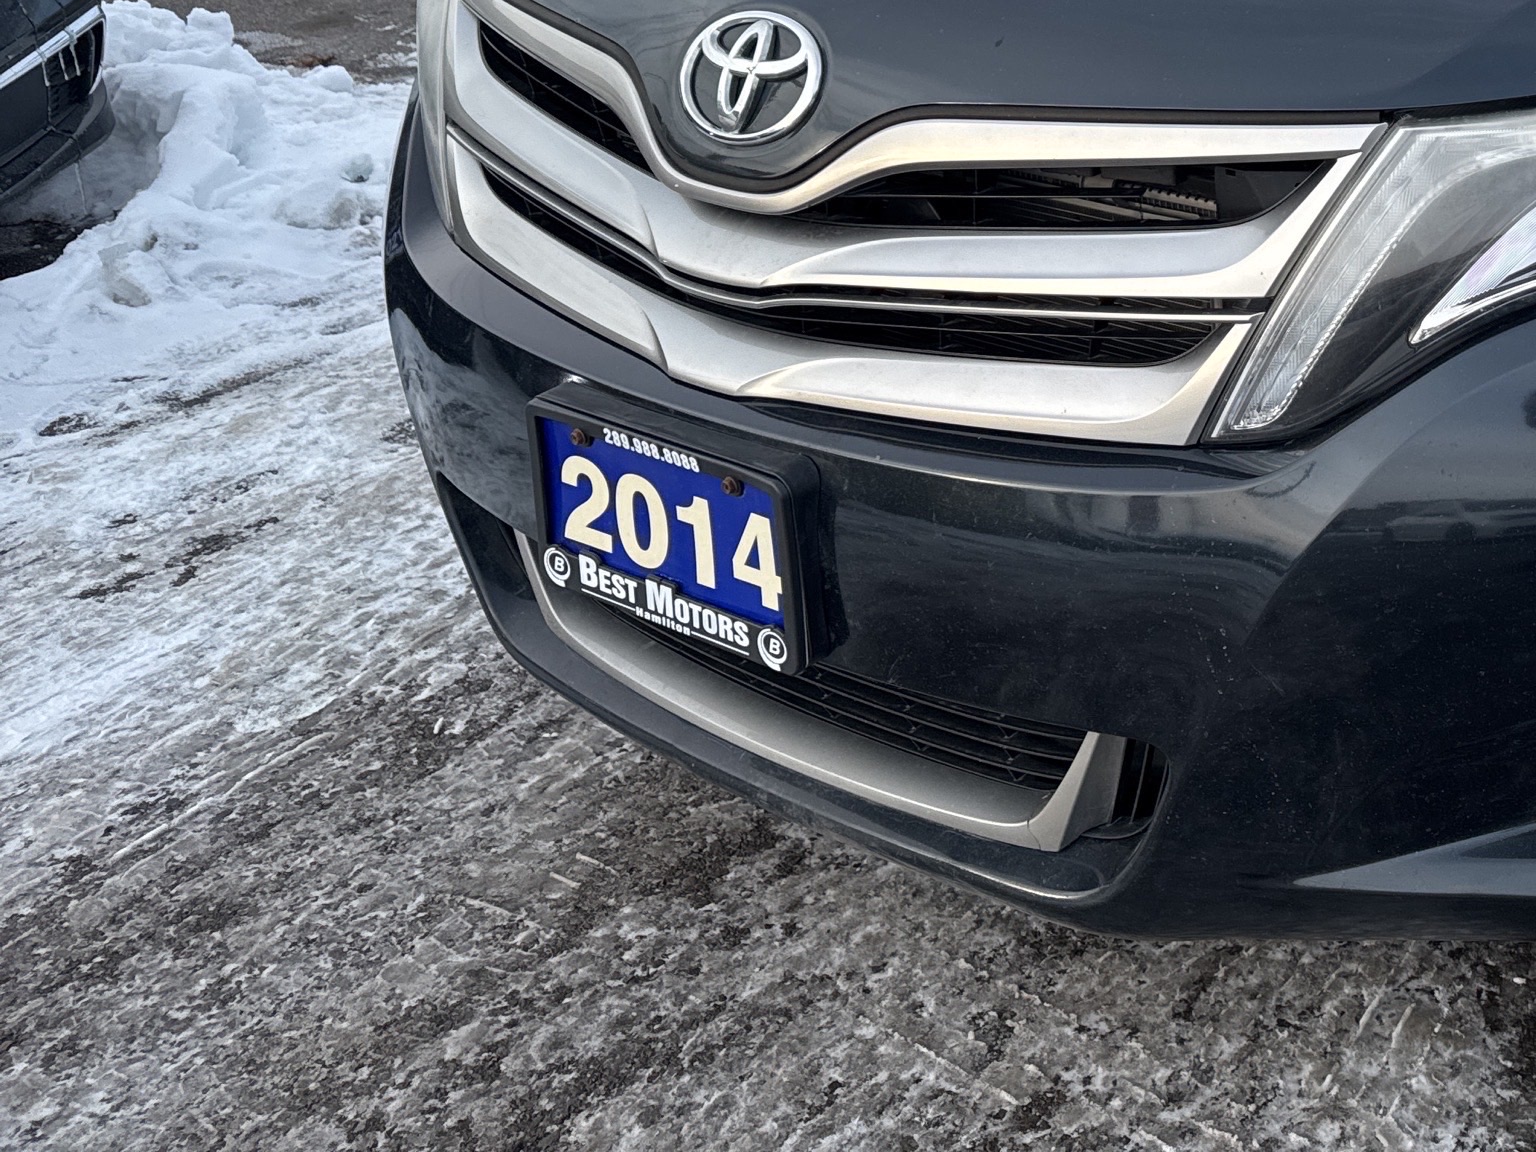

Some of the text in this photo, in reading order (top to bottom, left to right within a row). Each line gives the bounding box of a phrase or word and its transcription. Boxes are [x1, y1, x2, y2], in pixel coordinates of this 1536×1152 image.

[602, 427, 701, 473] 289.988.8088
[560, 454, 783, 612] 2014
[635, 606, 691, 637] Hamilton
